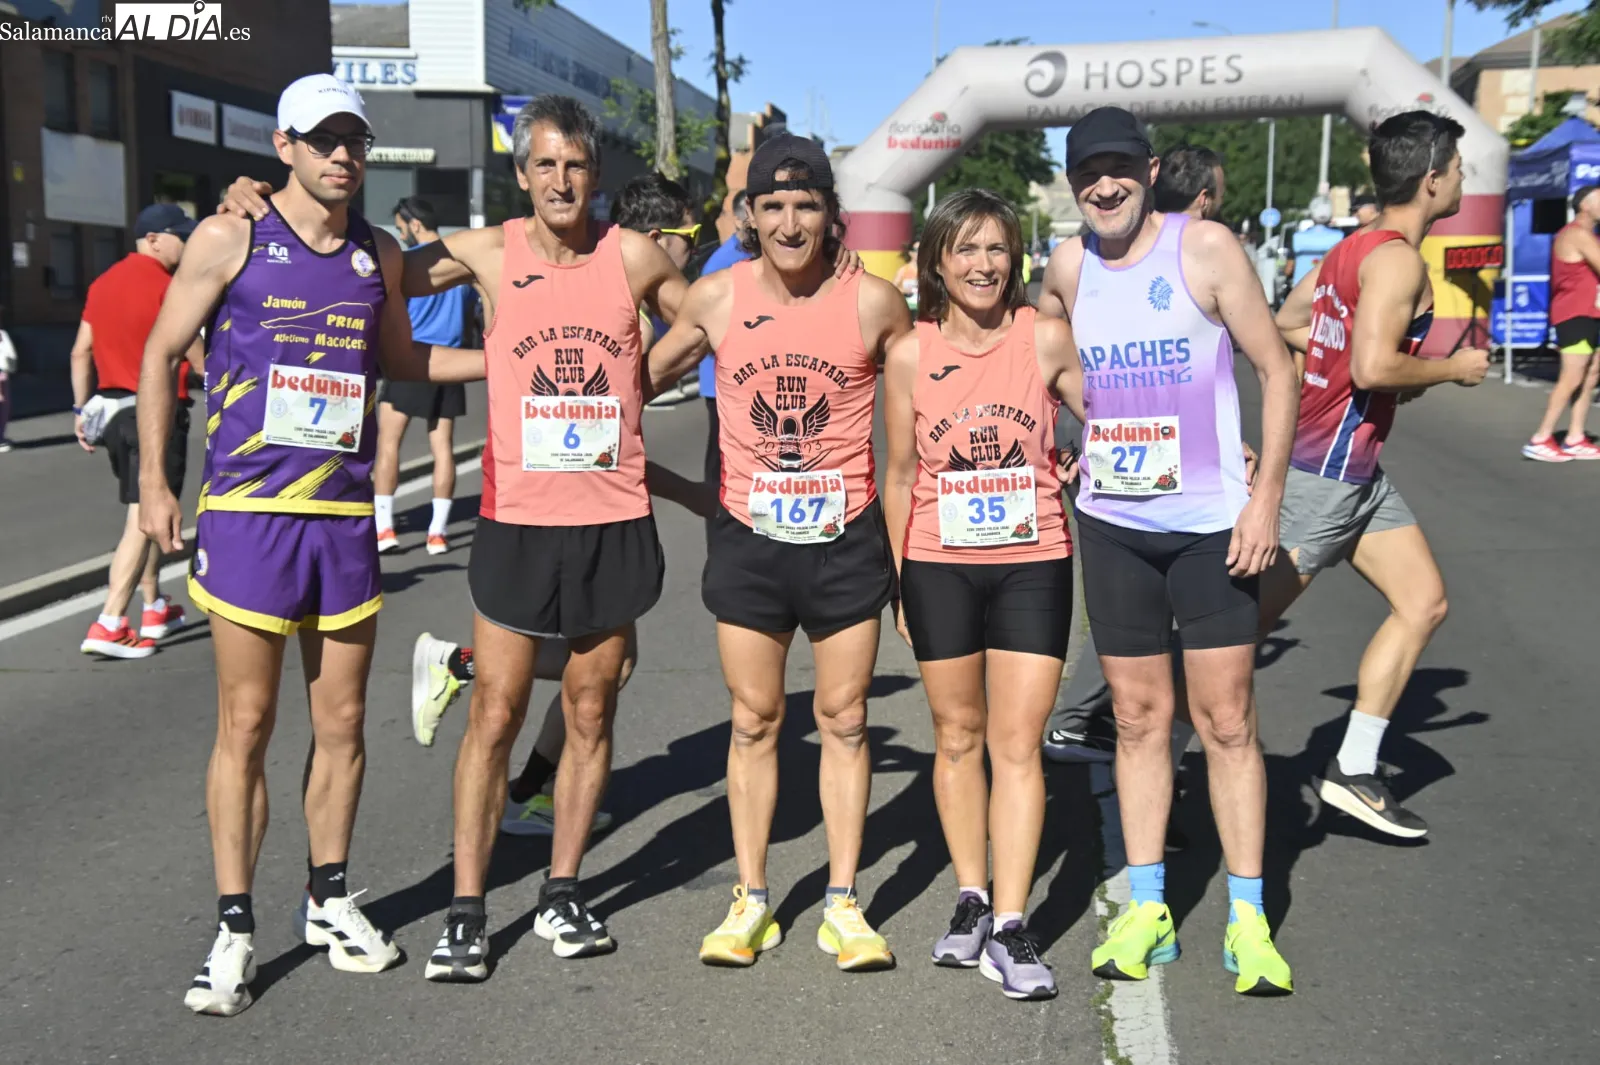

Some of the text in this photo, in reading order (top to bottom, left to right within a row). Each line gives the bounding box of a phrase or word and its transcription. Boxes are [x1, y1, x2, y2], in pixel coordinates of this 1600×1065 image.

[1084, 54, 1244, 90] HOSPES
[262, 295, 307, 310] Jamón
[326, 314, 366, 331] PRIM
[314, 333, 368, 350] Macotera
[512, 326, 622, 359] BAR LA ESCAPADA
[554, 348, 583, 365] RUN
[1079, 337, 1191, 372] APACHES
[555, 367, 585, 383] CLUB
[733, 354, 850, 390] BAR LA ESCAPADA
[1087, 366, 1193, 390] RUNNING
[271, 370, 362, 399] bedunia
[776, 376, 807, 393] RUN
[309, 397, 327, 425] 7
[525, 401, 616, 419] bedunia
[775, 394, 807, 411] CLUB
[929, 418, 952, 443] BAR
[976, 404, 1037, 433] ESCAPADA
[1089, 422, 1176, 442] bedunia
[563, 423, 580, 449] 6
[970, 444, 1002, 463] CLUB
[1111, 446, 1147, 473] 27
[753, 475, 842, 495] bedunia
[941, 473, 1032, 495] bedunia
[770, 497, 826, 523] 167
[968, 496, 1006, 524] 35
